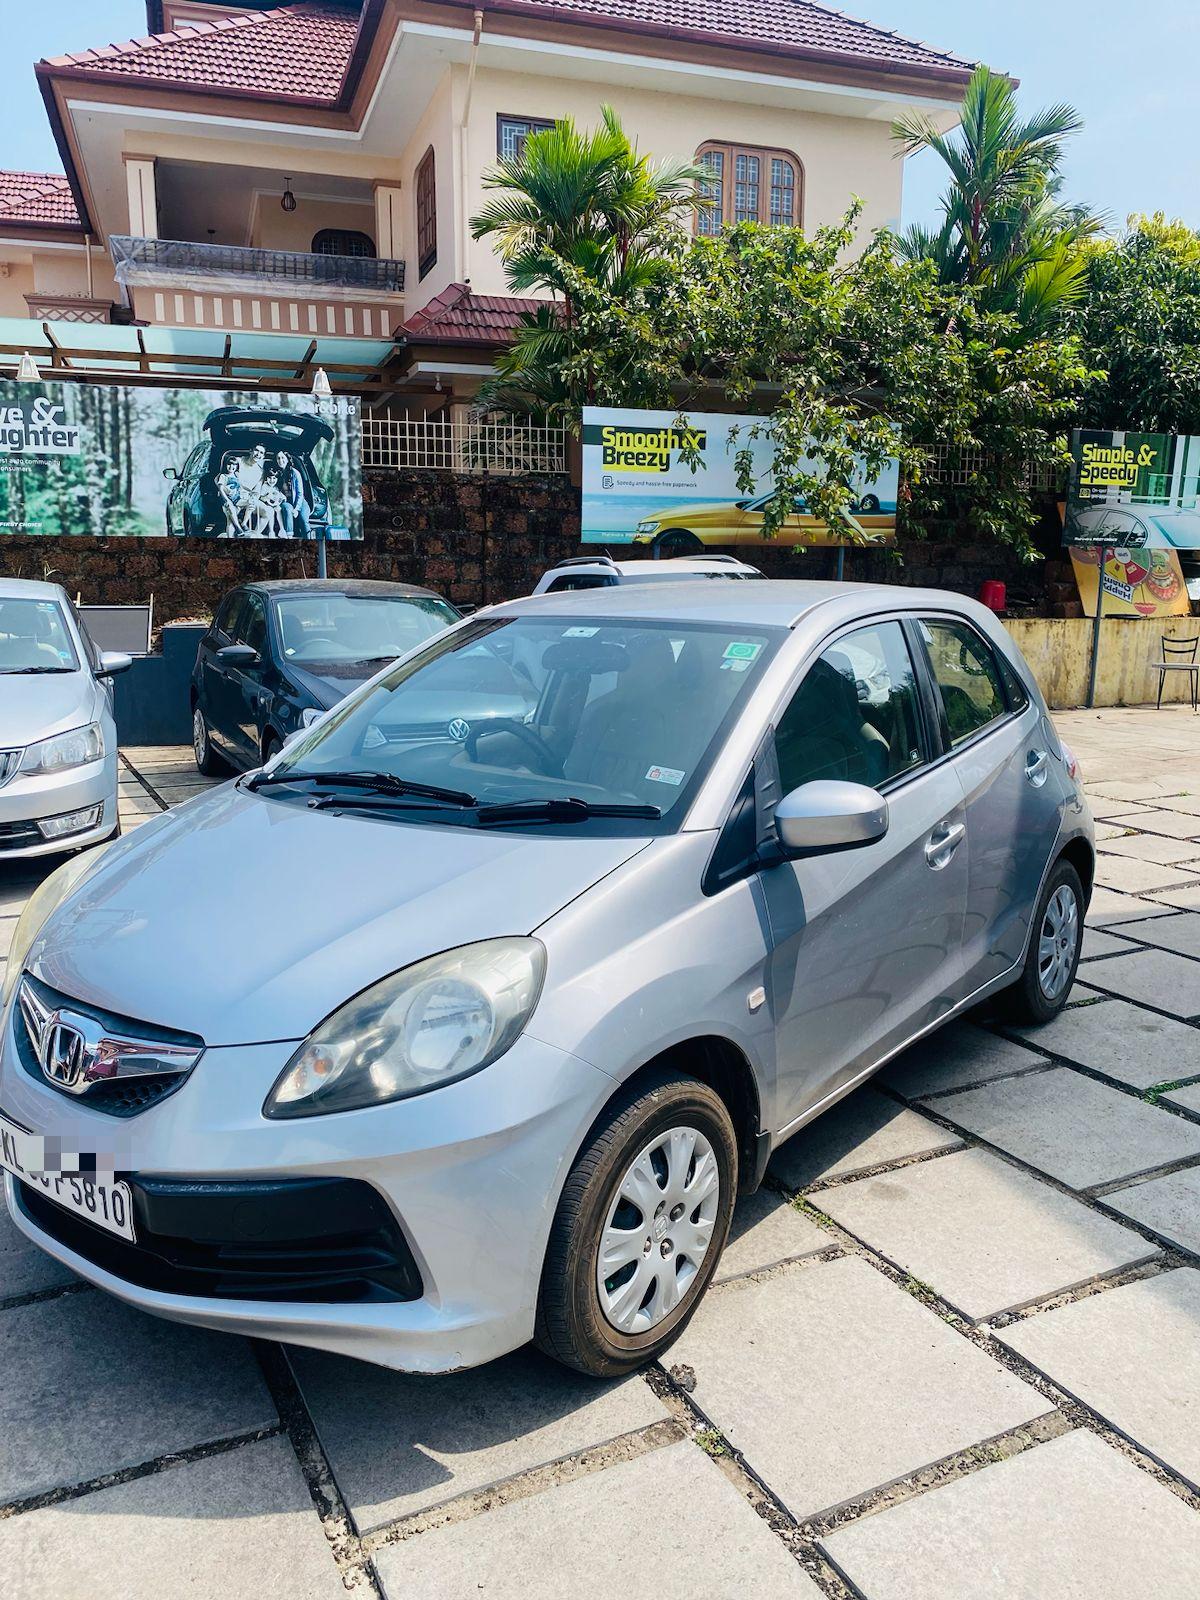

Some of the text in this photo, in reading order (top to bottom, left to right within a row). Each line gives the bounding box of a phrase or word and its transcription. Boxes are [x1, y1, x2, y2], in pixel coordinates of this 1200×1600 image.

[31, 396, 64, 426] &
[602, 426, 679, 450] Smooth
[602, 445, 671, 472] Breezy
[1082, 442, 1158, 466] Simple &
[1080, 464, 1136, 485] Speedy
